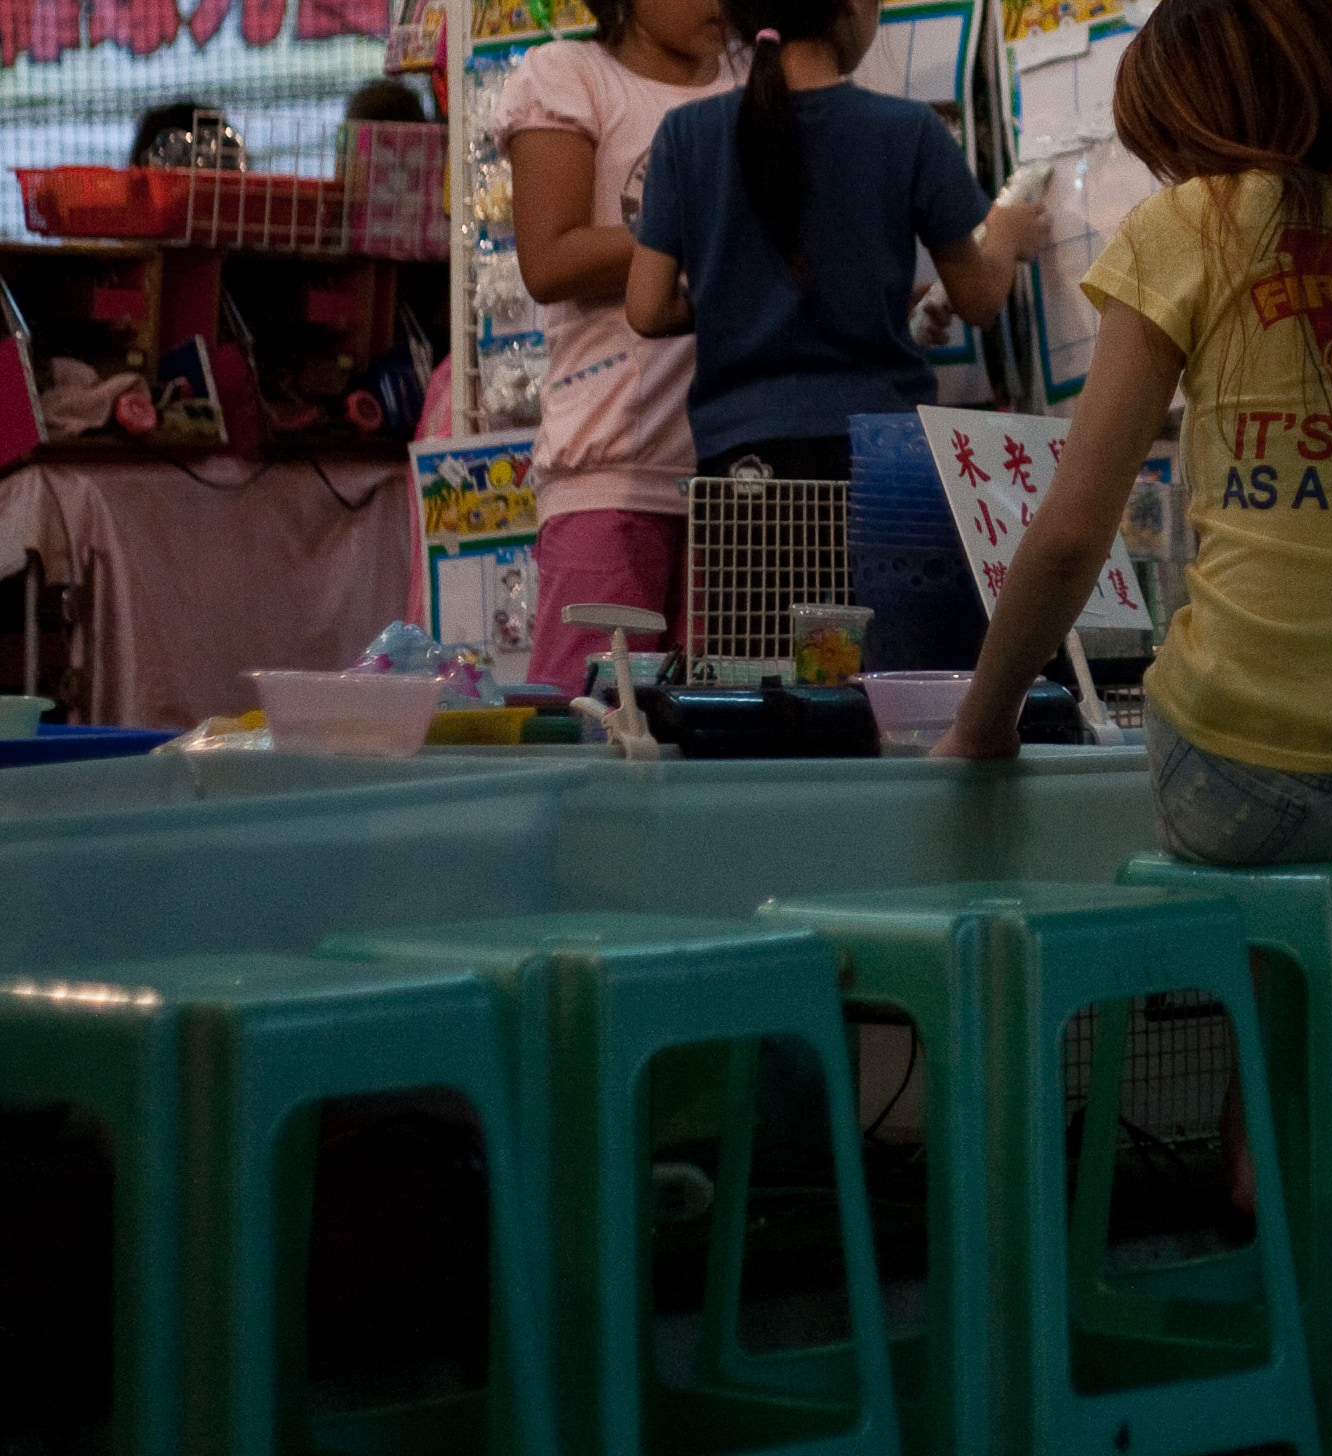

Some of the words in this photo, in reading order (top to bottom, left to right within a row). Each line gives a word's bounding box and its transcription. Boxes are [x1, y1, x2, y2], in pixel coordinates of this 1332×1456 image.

[468, 454, 532, 491] TOY
[1222, 465, 1279, 511] AS
[1291, 465, 1330, 511] A
